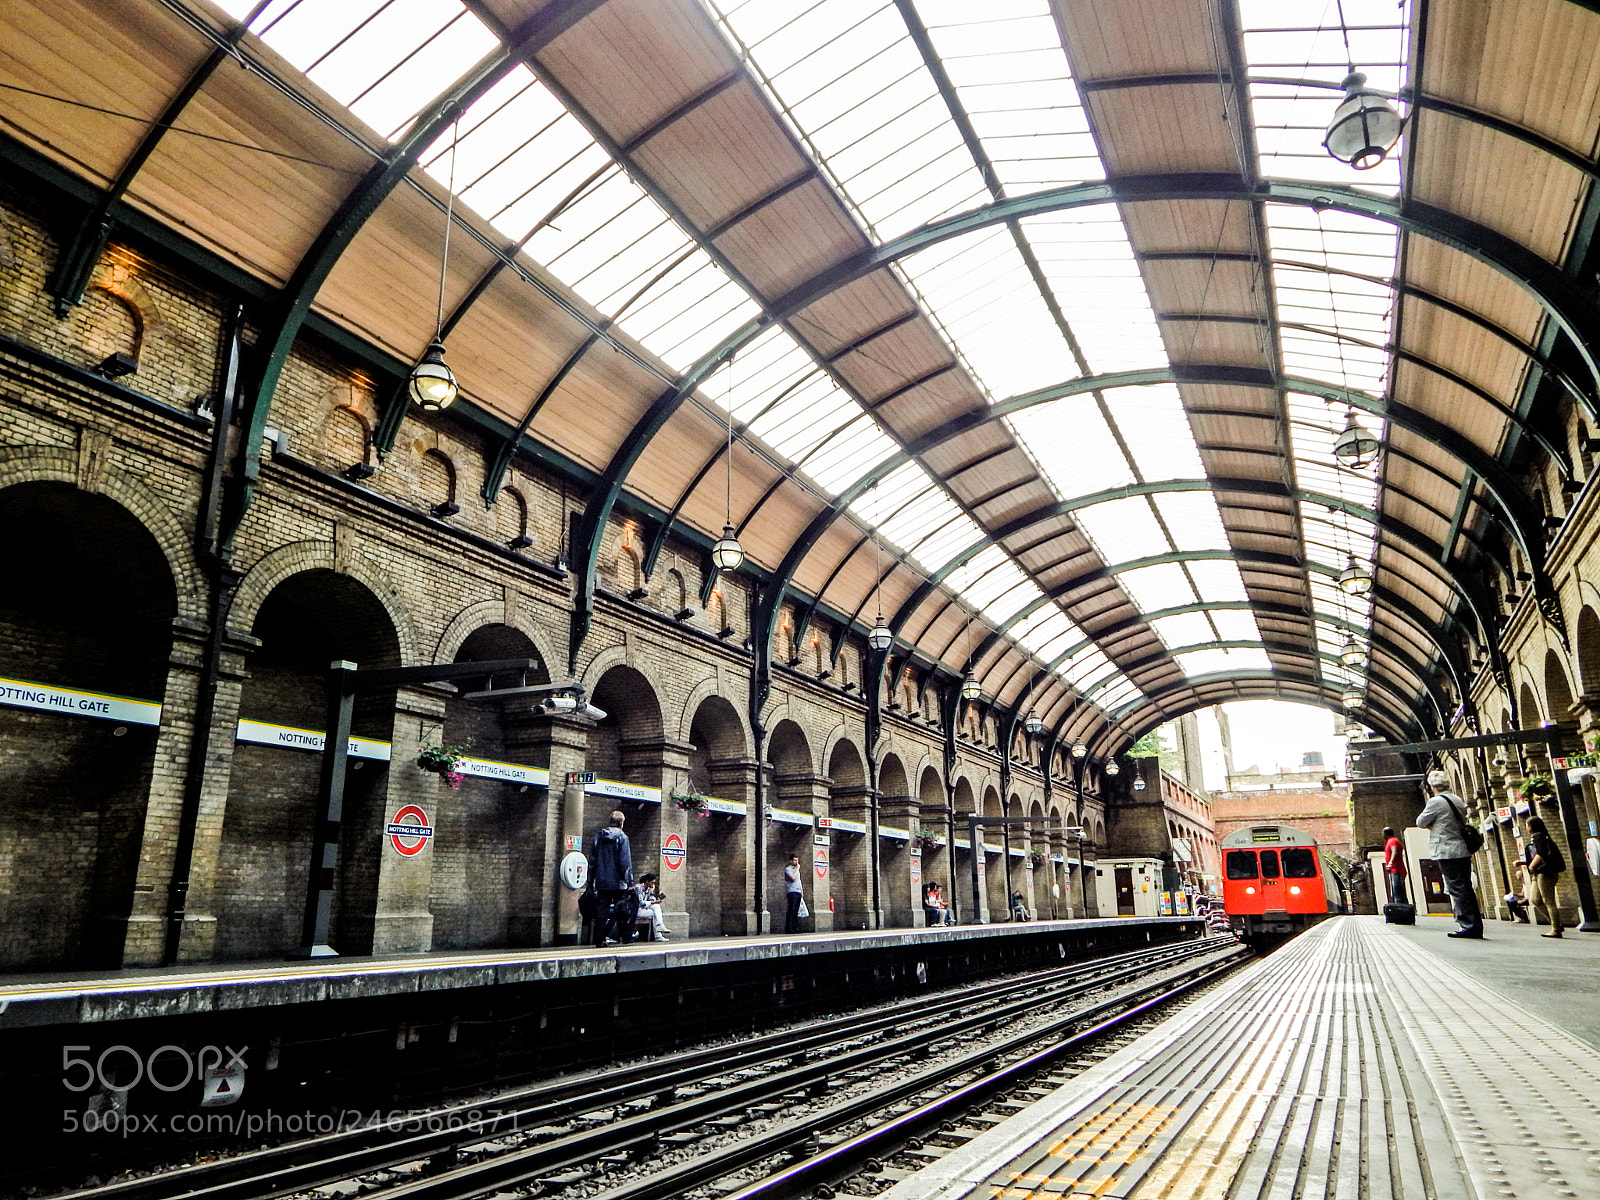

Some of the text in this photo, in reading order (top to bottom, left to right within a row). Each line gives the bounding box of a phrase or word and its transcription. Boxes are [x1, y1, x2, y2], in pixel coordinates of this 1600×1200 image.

[49, 695, 75, 708] HILL
[79, 700, 110, 713] GATE
[278, 732, 318, 746] NOTTING
[471, 764, 526, 779] NOTTING HILL GATE
[604, 785, 625, 794] NOTTING
